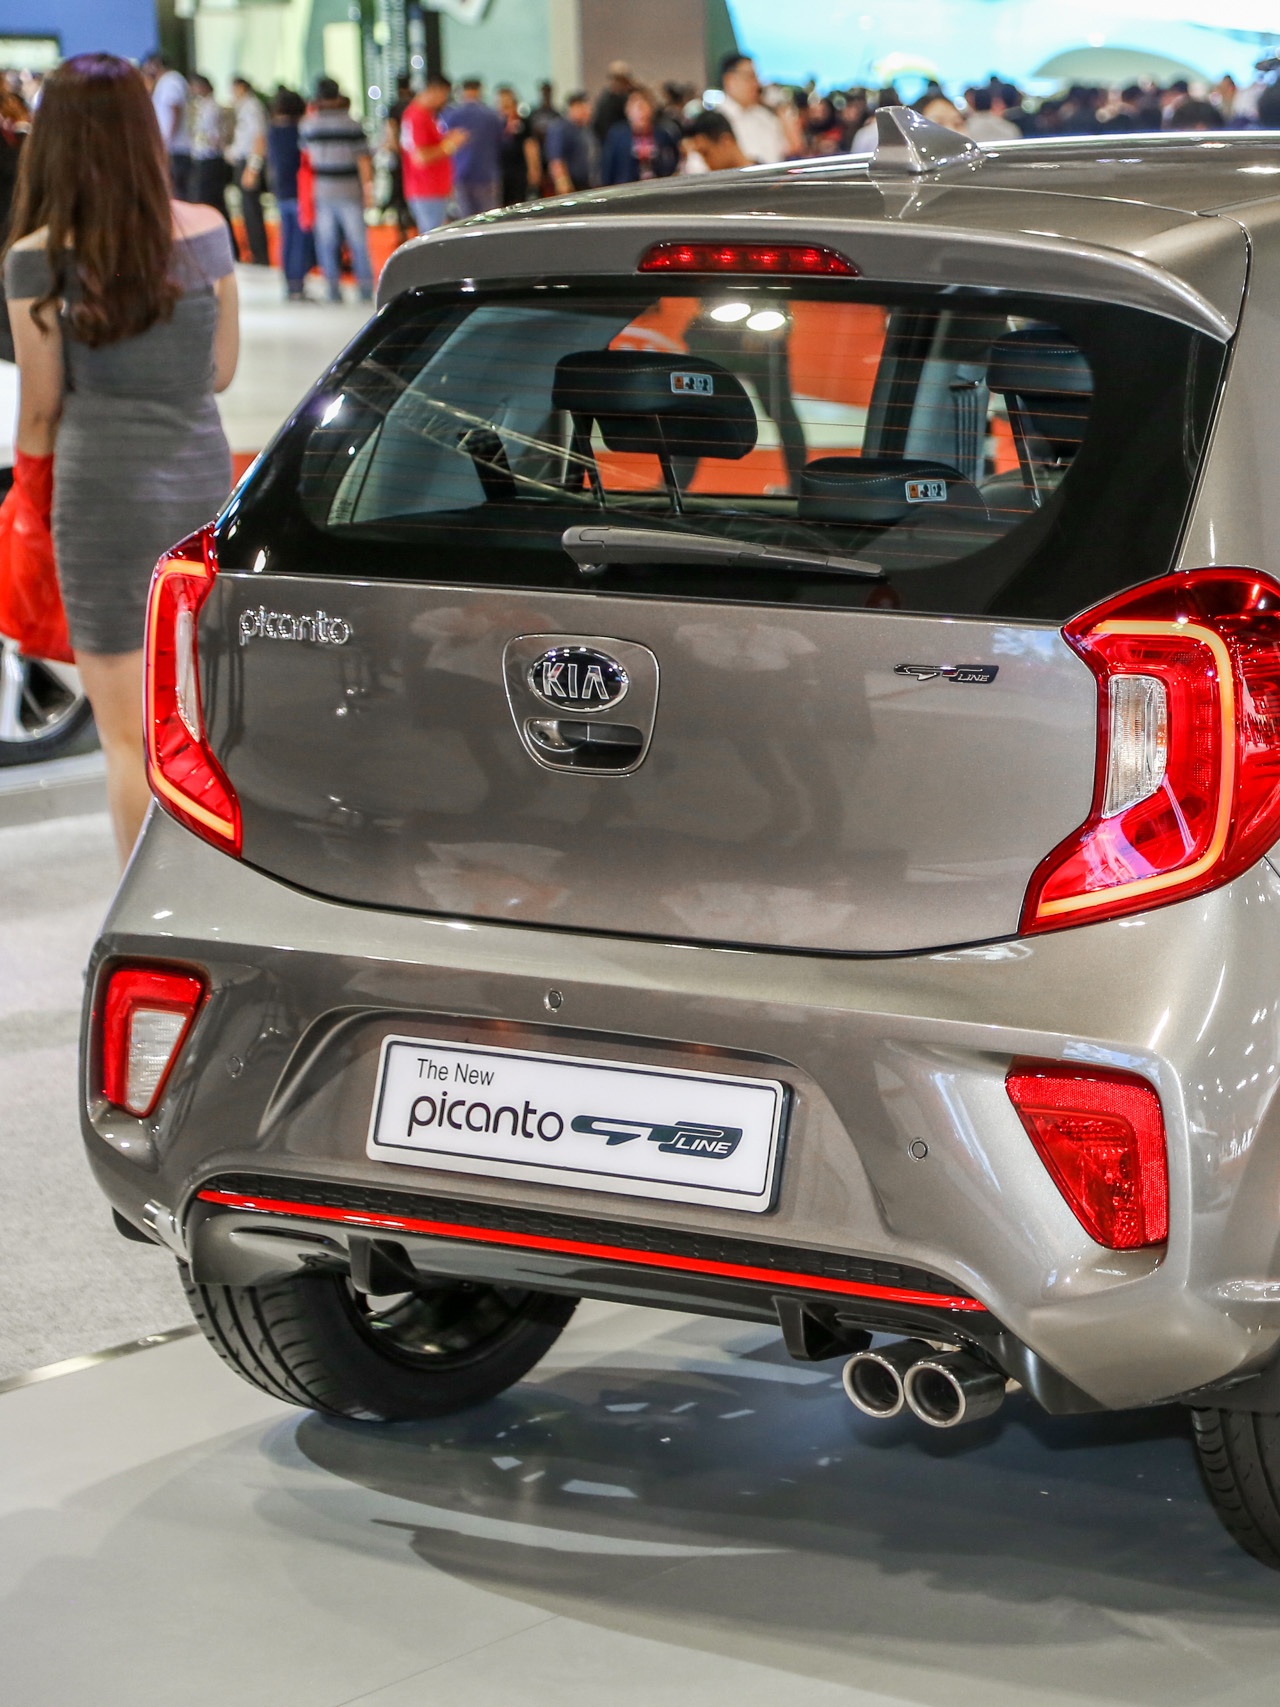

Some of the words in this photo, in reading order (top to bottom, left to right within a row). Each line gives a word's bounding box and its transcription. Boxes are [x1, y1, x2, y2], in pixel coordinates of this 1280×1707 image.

[239, 605, 353, 646] picanto
[543, 662, 610, 700] KIA
[957, 673, 990, 682] LINE
[417, 1058, 449, 1081] The
[454, 1063, 495, 1086] New
[407, 1091, 564, 1142] picanto
[675, 1137, 732, 1154] LINE
